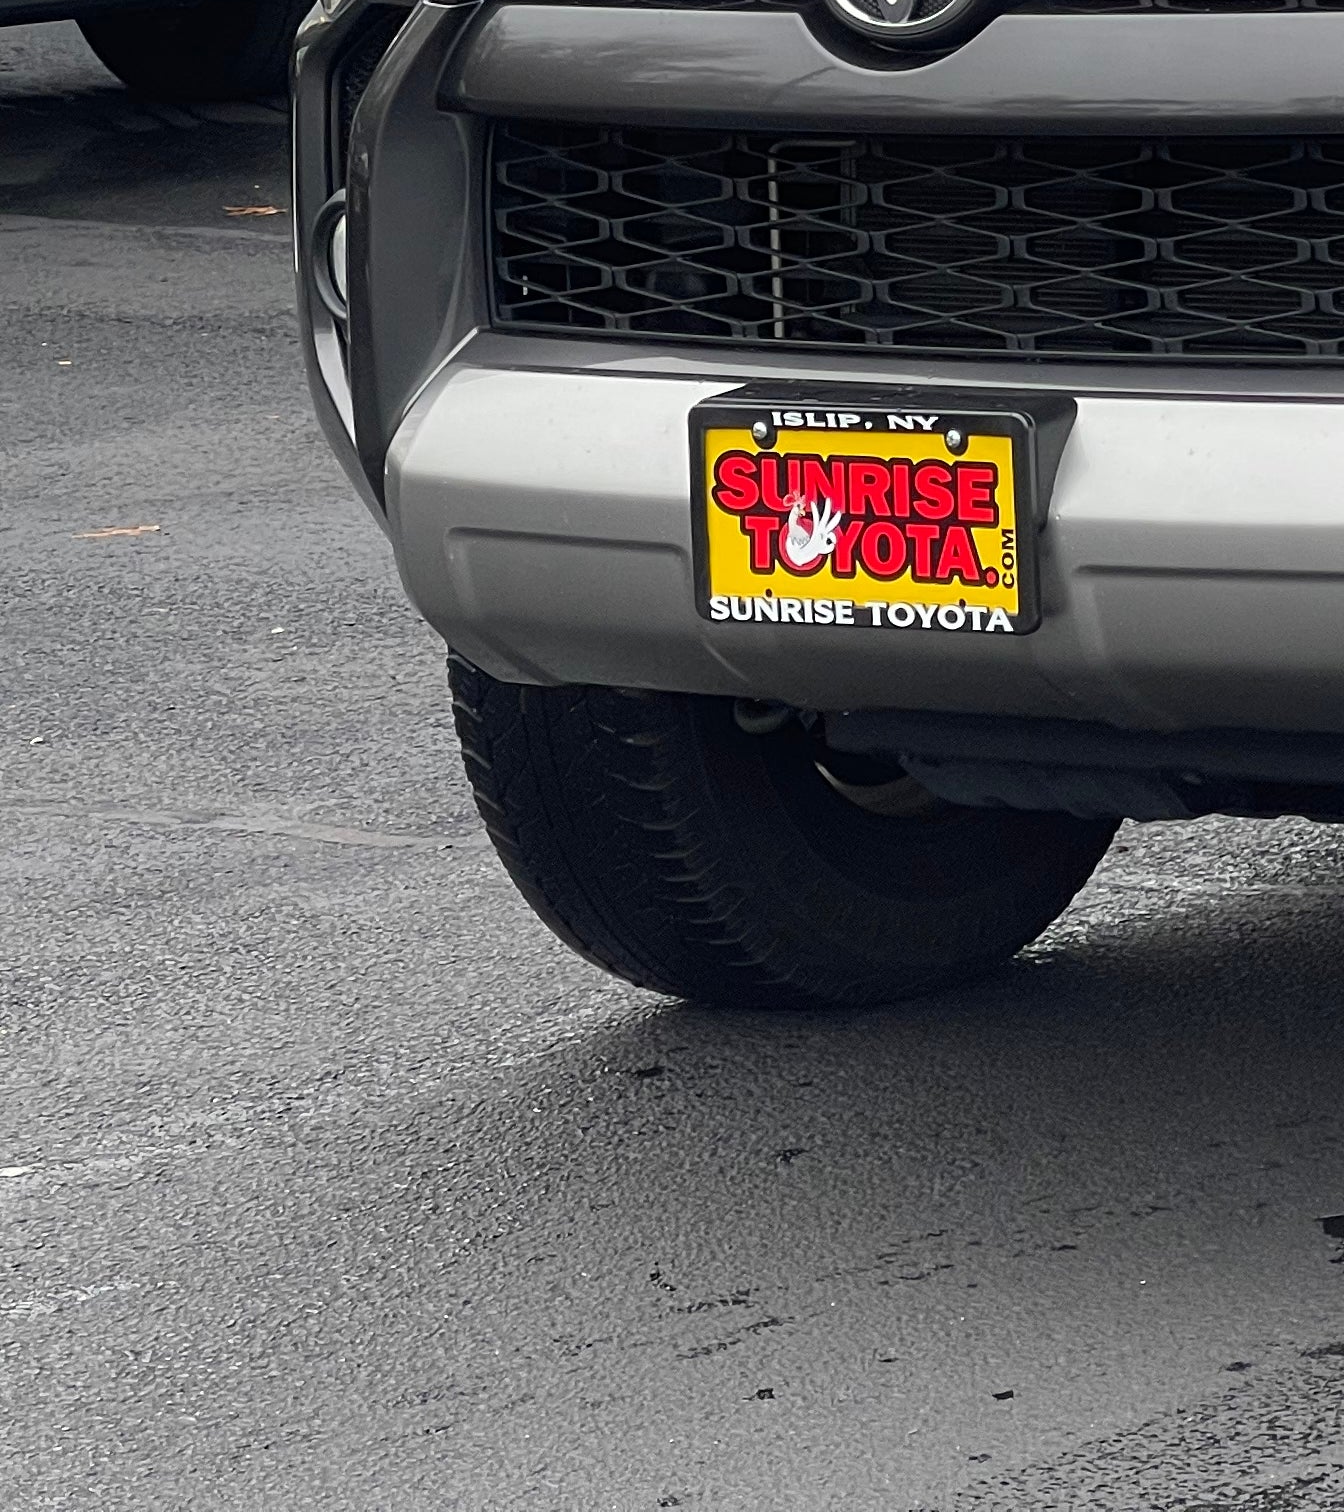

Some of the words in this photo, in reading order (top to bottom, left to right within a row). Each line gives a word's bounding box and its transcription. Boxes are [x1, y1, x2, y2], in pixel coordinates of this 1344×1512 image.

[770, 411, 872, 431] ISLIP,
[887, 413, 939, 431] NY
[714, 453, 996, 524] SUNRISE
[709, 596, 856, 625] SUNRISE
[865, 601, 1015, 633] TOYOTA
